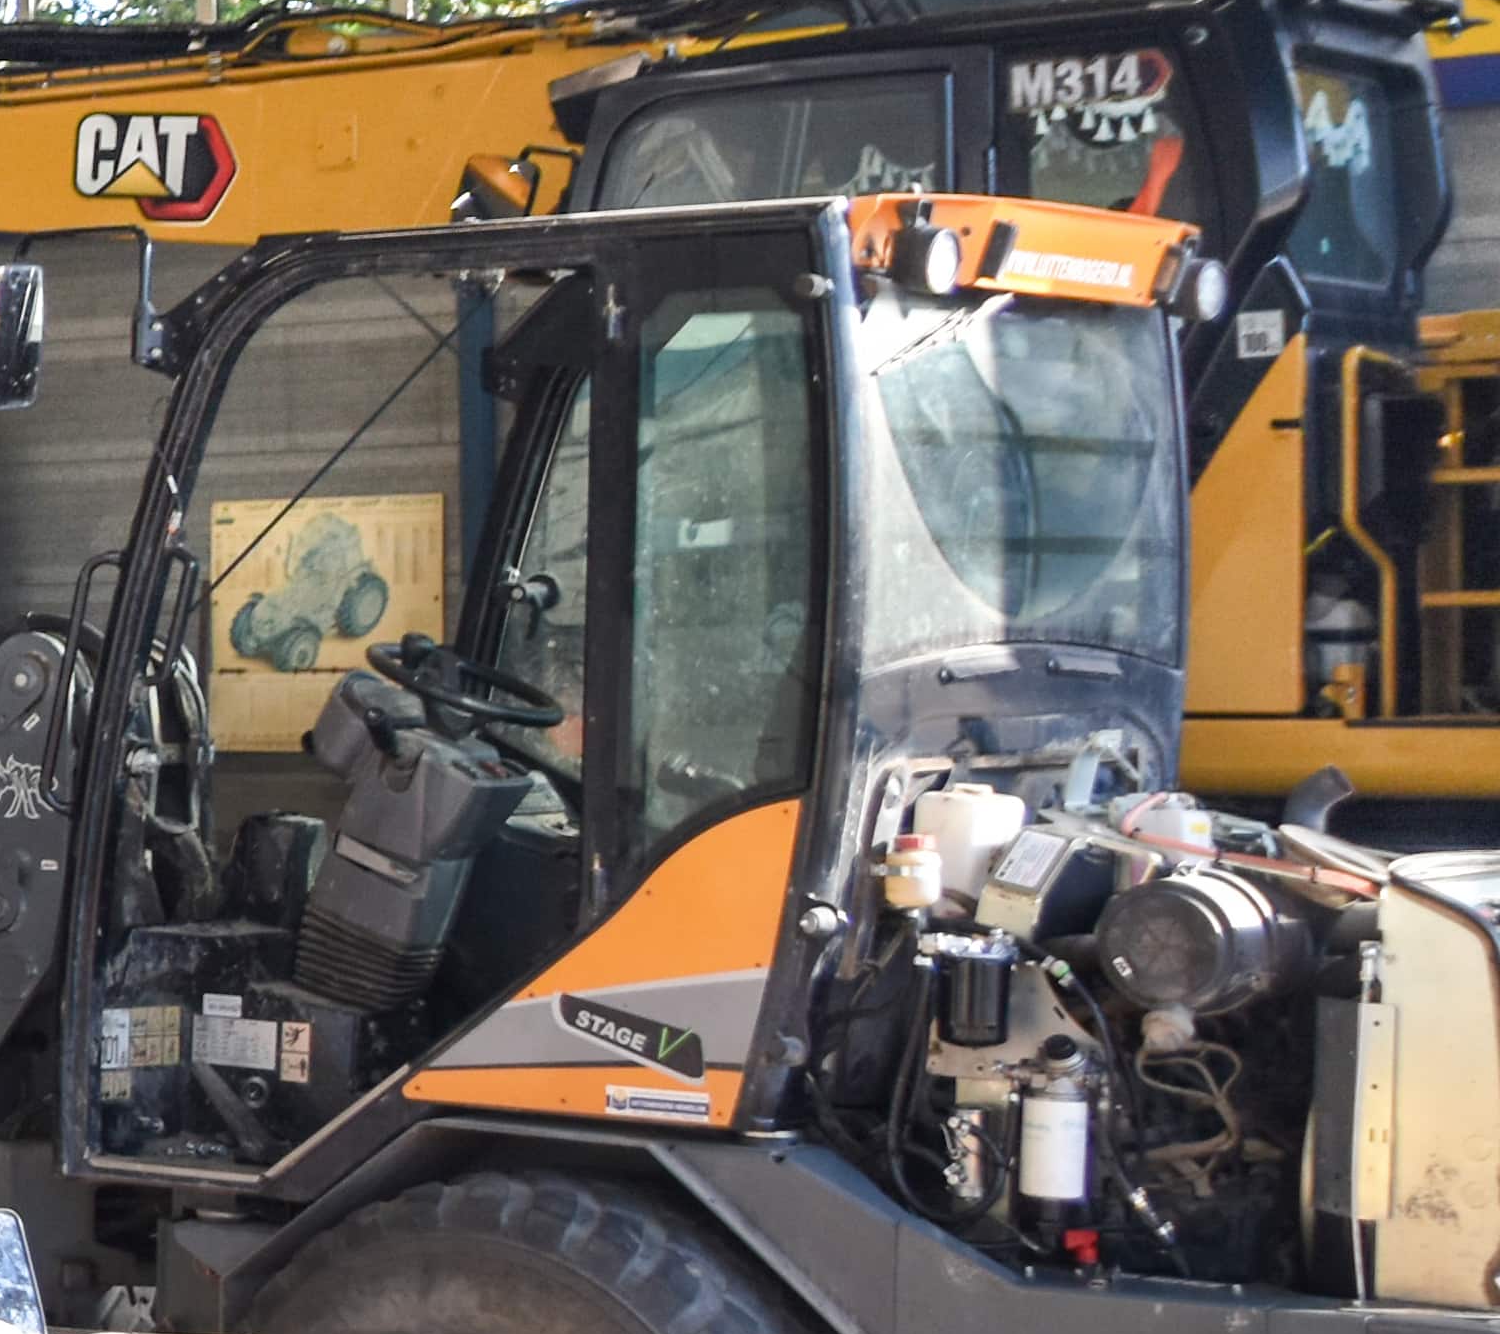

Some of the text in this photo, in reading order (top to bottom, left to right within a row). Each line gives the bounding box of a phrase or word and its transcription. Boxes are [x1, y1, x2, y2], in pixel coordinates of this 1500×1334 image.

[1010, 53, 1142, 109] M314
[77, 114, 200, 199] CAT
[575, 1009, 693, 1060] STAGE V
